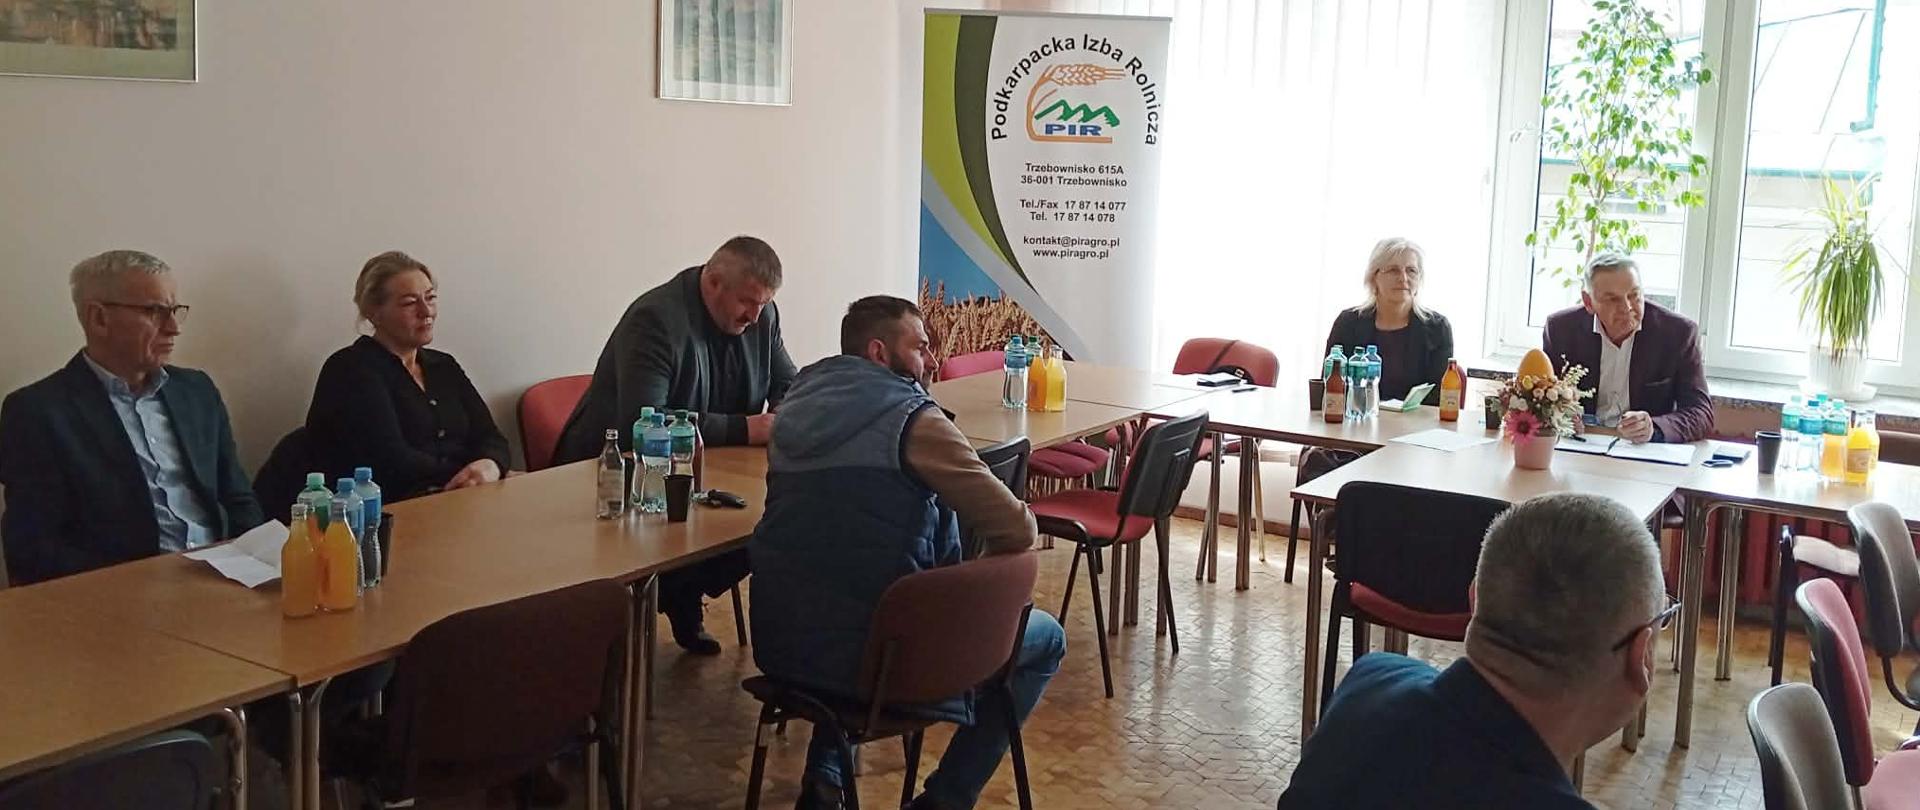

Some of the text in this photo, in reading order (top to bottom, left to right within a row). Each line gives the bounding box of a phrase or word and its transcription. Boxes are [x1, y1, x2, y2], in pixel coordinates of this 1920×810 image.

[991, 34, 1161, 145] Podkarpacka Izba Rolnicza
[1045, 124, 1103, 136] PIR
[1025, 163, 1124, 174] Trzebownisko 615A
[1021, 175, 1127, 187] 36-001 Trzebownisko
[1020, 199, 1126, 211] Tel./Fax 17 87 14 077
[1030, 211, 1115, 223] Tel. 17 87 14 078
[1023, 236, 1120, 248] kontakt@piragro.pl
[1033, 249, 1109, 260] www.piragro.pl
